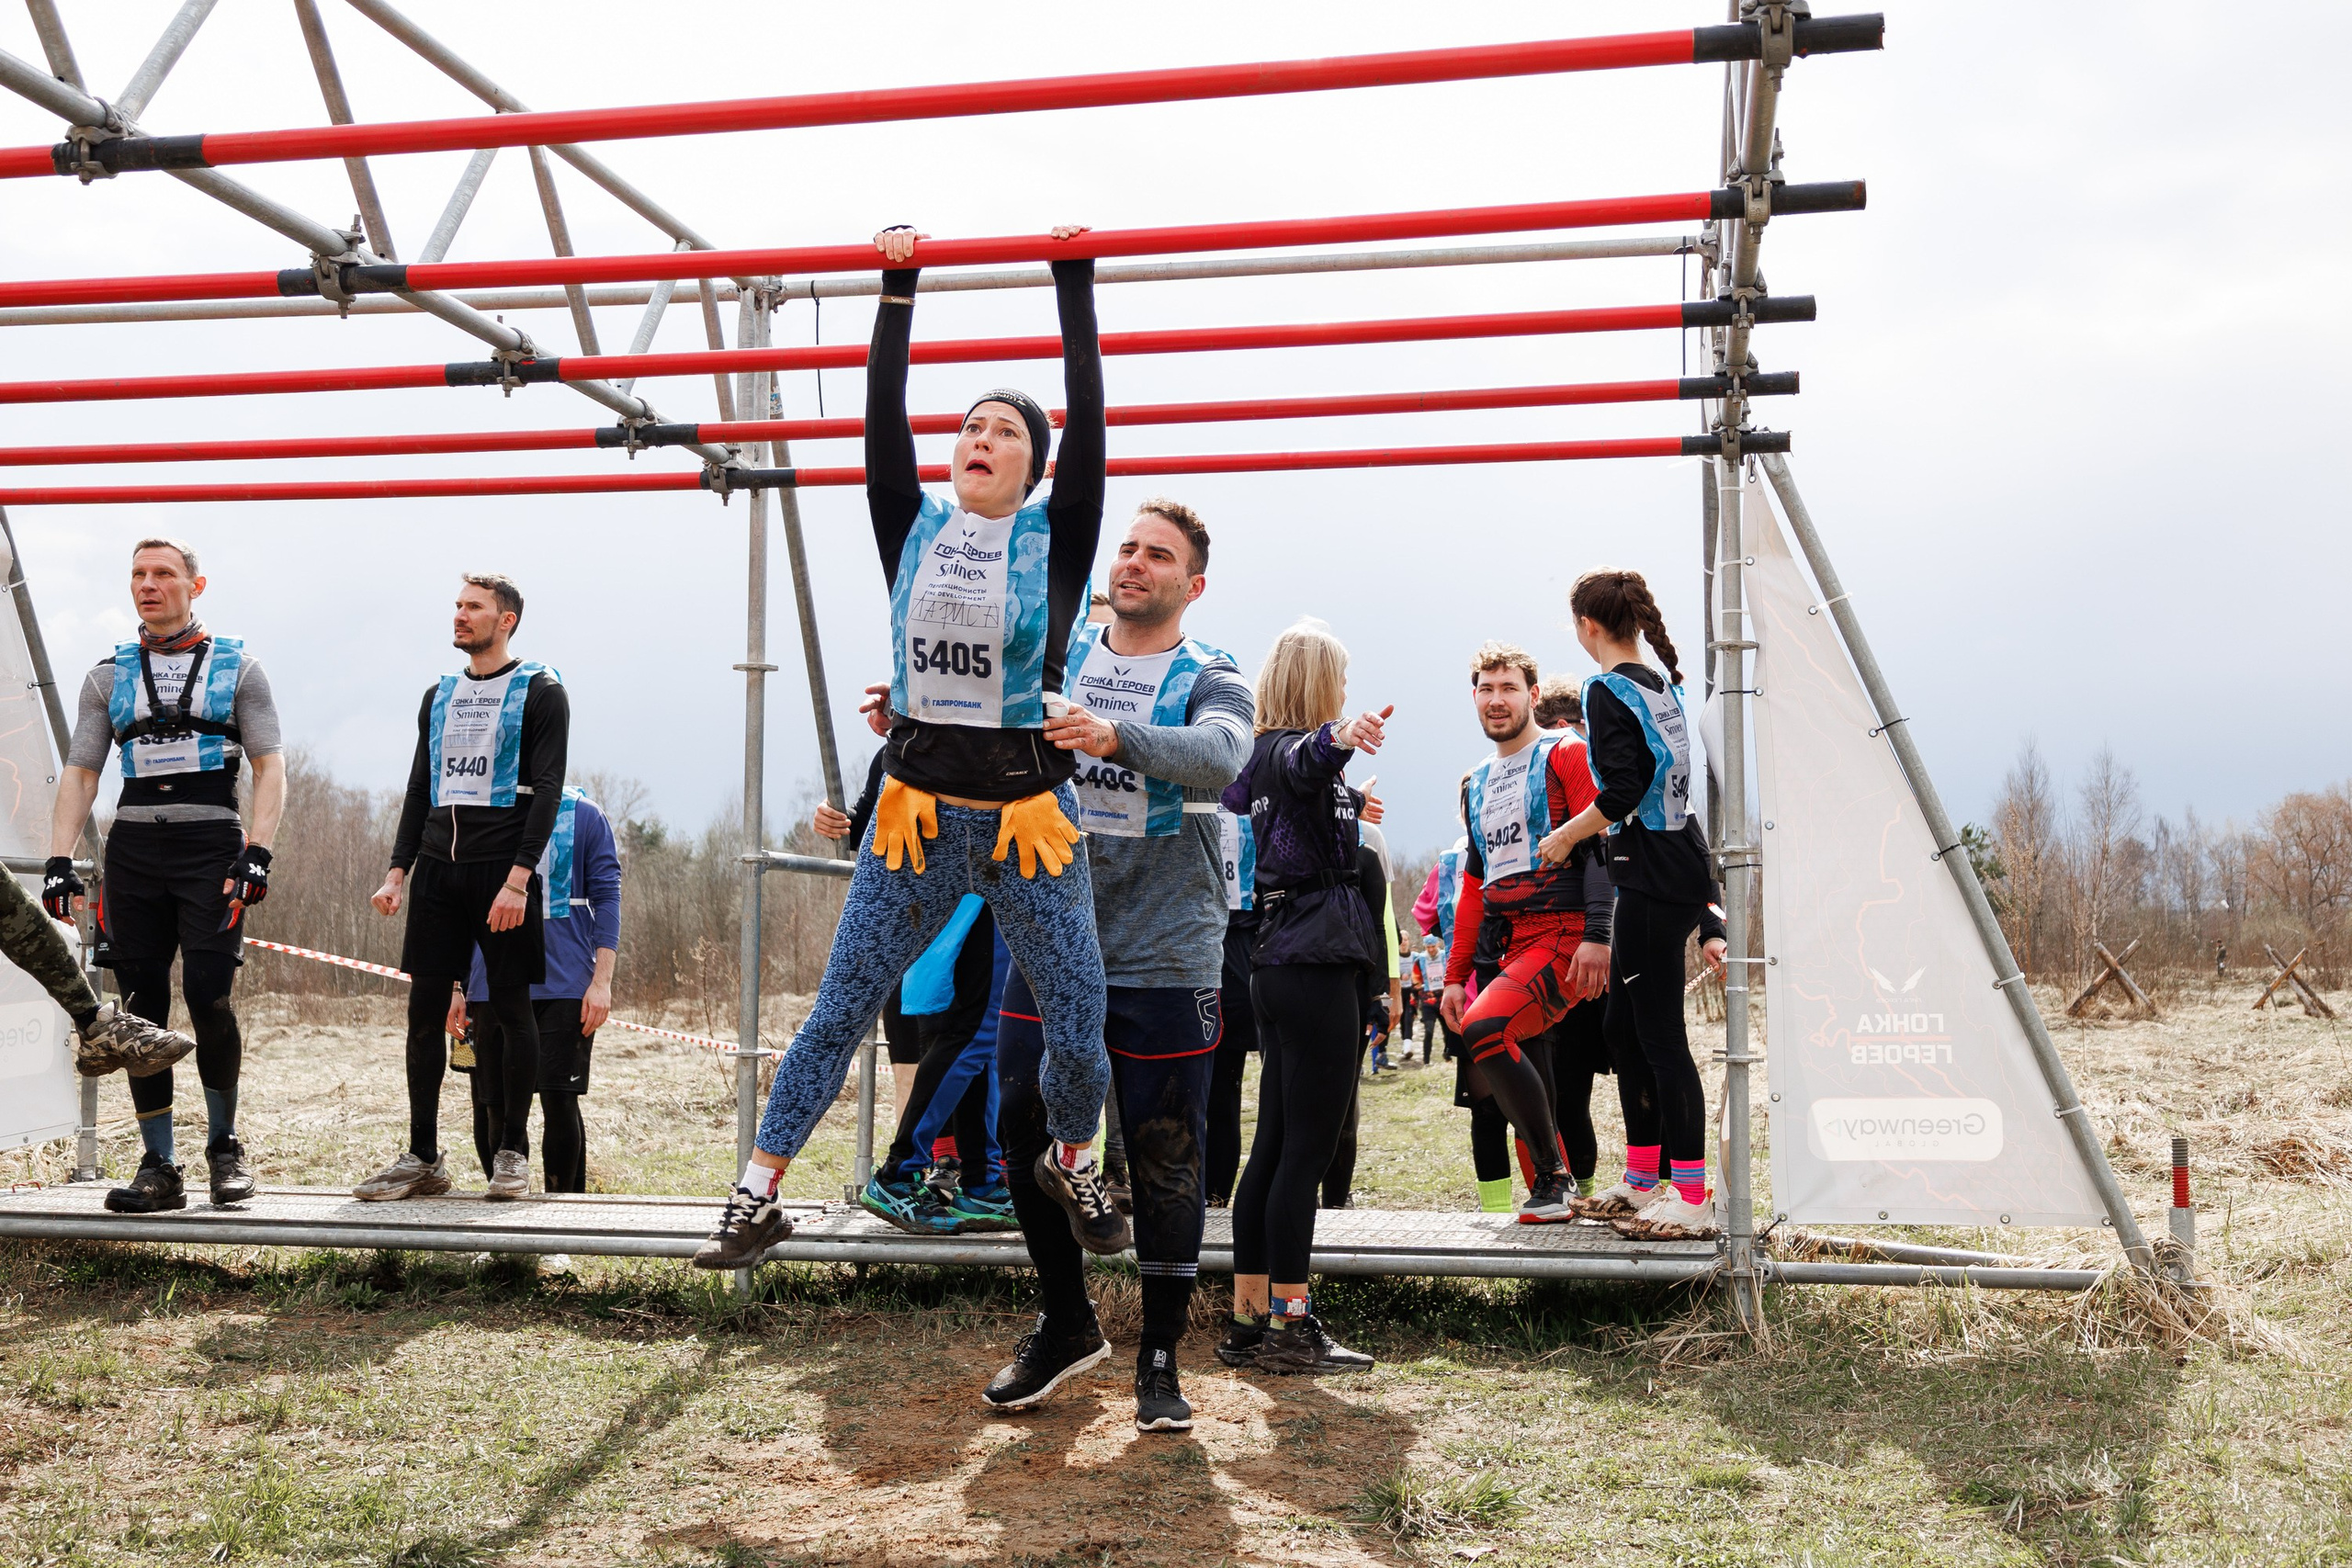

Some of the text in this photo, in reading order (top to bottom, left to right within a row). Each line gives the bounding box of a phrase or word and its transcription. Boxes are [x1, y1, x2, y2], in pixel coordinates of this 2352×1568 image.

[935, 541, 1003, 559] ГОН ГЕРОЕВ
[937, 591, 987, 602] DEVELOPMENT
[912, 637, 992, 679] 5405
[171, 672, 203, 682] ГЕРВ
[1080, 674, 1156, 694] ГОНКА ГЕРОЕВ
[156, 683, 185, 694] mine
[932, 698, 982, 709] ГАЗПРОМБАНК
[1084, 692, 1138, 713] Sminex
[456, 708, 491, 719] Sminex
[446, 755, 488, 778] 5440
[1087, 809, 1129, 820] ГАЗПРОМБАНК
[1487, 821, 1522, 853] 5402
